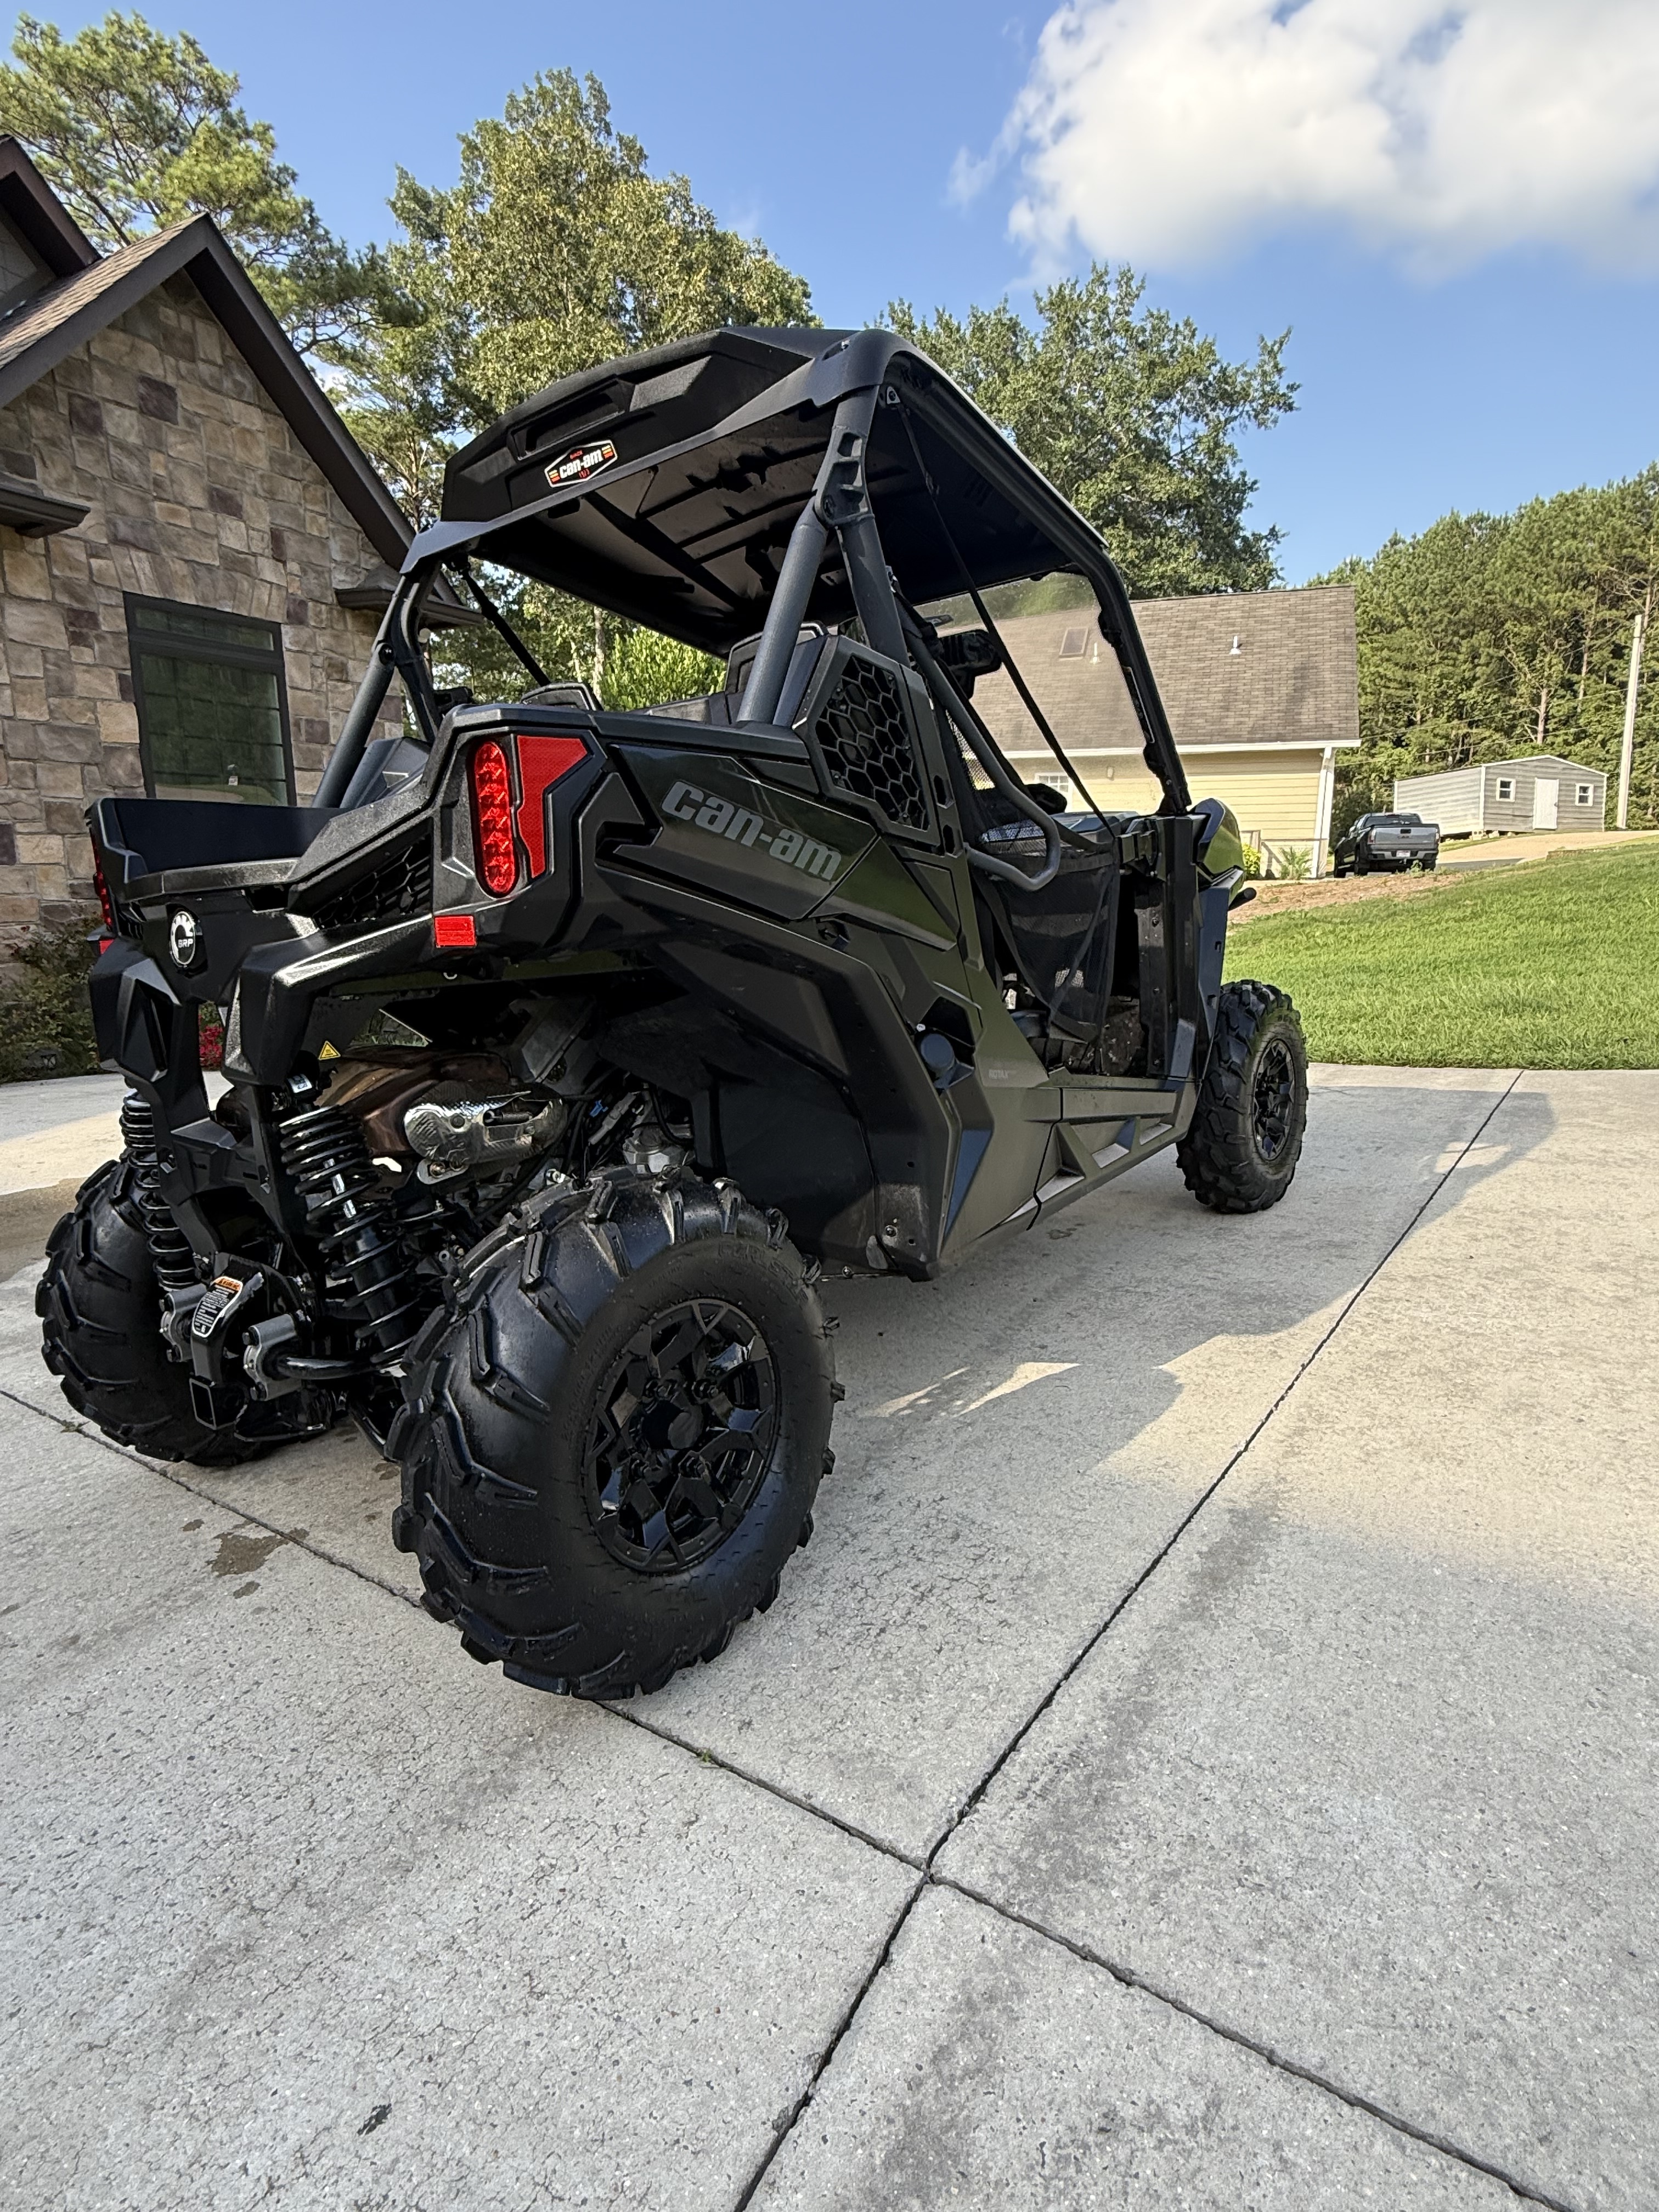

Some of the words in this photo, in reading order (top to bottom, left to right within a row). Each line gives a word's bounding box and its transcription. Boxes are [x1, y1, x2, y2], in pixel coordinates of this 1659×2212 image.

[559, 449, 602, 478] can-am
[662, 781, 842, 880] can-am
[178, 939, 193, 947] BRP
